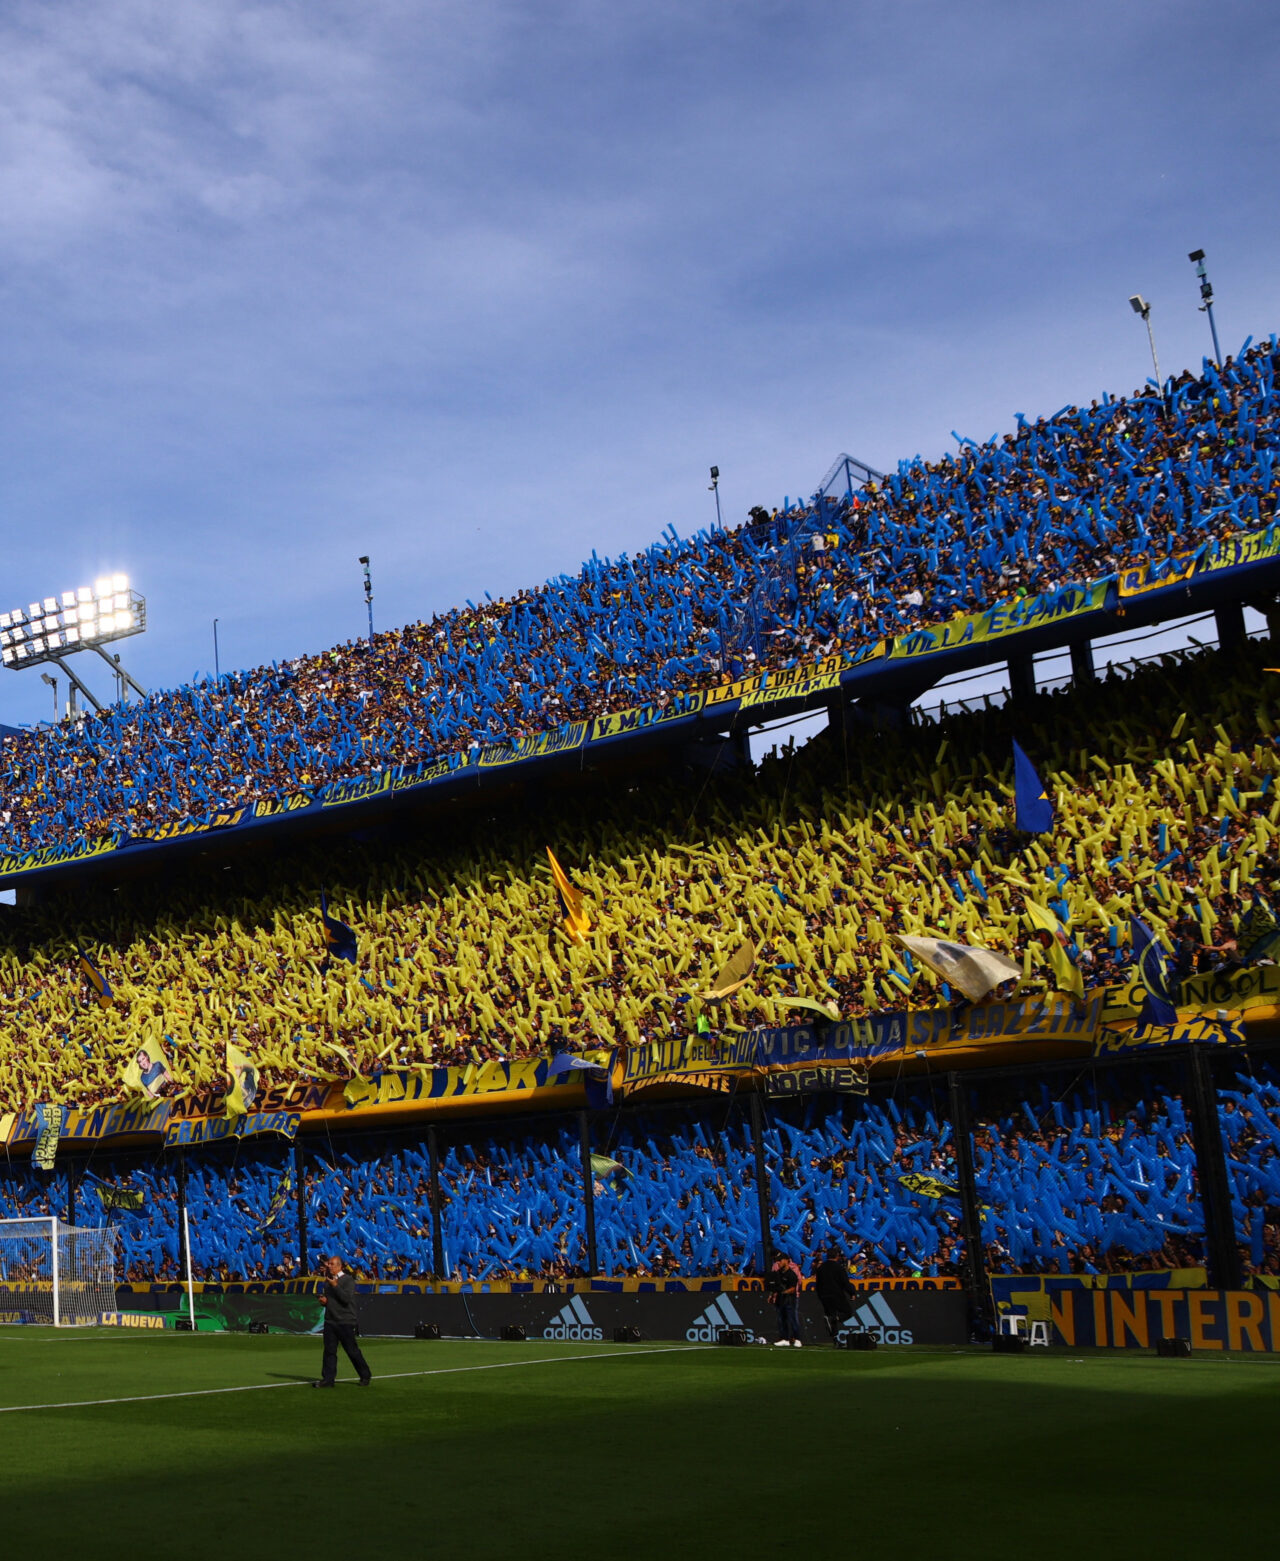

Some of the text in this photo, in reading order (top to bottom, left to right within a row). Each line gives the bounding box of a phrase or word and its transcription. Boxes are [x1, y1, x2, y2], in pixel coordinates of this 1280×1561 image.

[738, 671, 840, 711] MAGDALENA
[169, 1086, 332, 1118] ANDRSON
[15, 1098, 172, 1140] HULINGHAM
[166, 1111, 301, 1145] GRAND BOURG
[101, 1312, 118, 1325] LA
[121, 1313, 164, 1328] NUEVA
[543, 1324, 603, 1340] adidas
[686, 1324, 755, 1342] adis
[836, 1325, 914, 1345] adas
[1093, 1290, 1280, 1352] INTER
